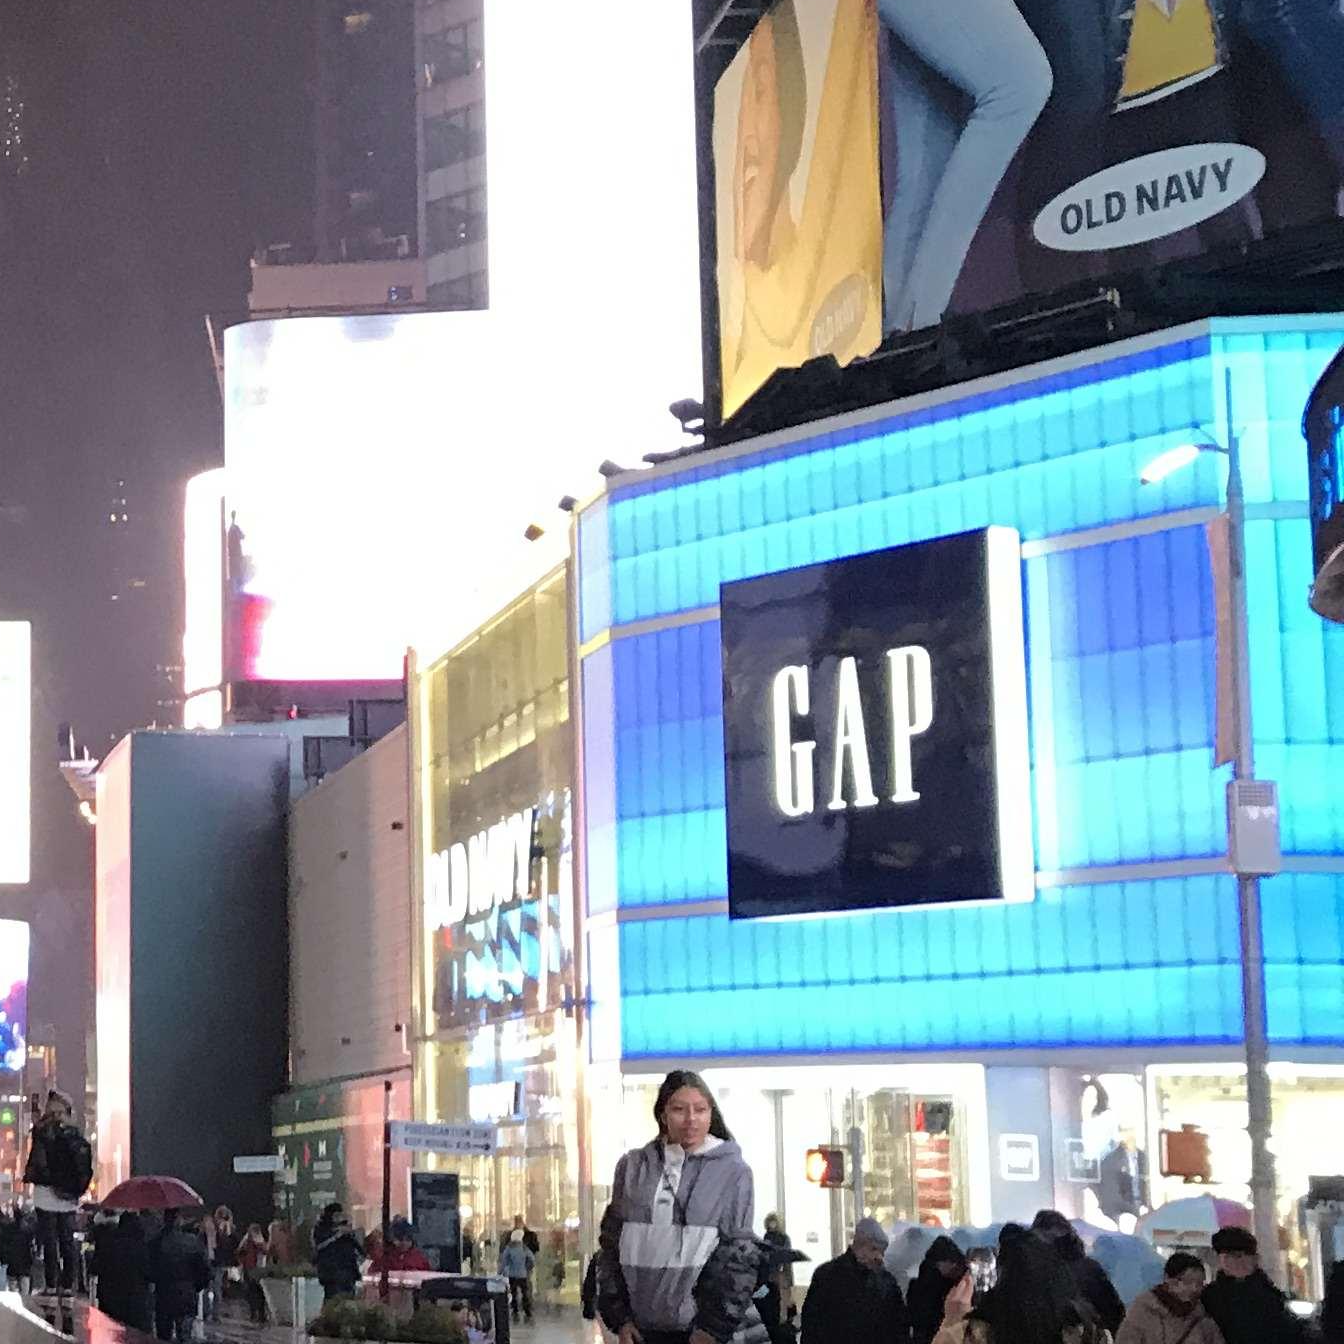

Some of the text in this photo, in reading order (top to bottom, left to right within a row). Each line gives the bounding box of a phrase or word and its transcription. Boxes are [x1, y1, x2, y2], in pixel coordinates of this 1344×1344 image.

[1060, 158, 1233, 234] OLD NAVY
[773, 645, 934, 817] GAP
